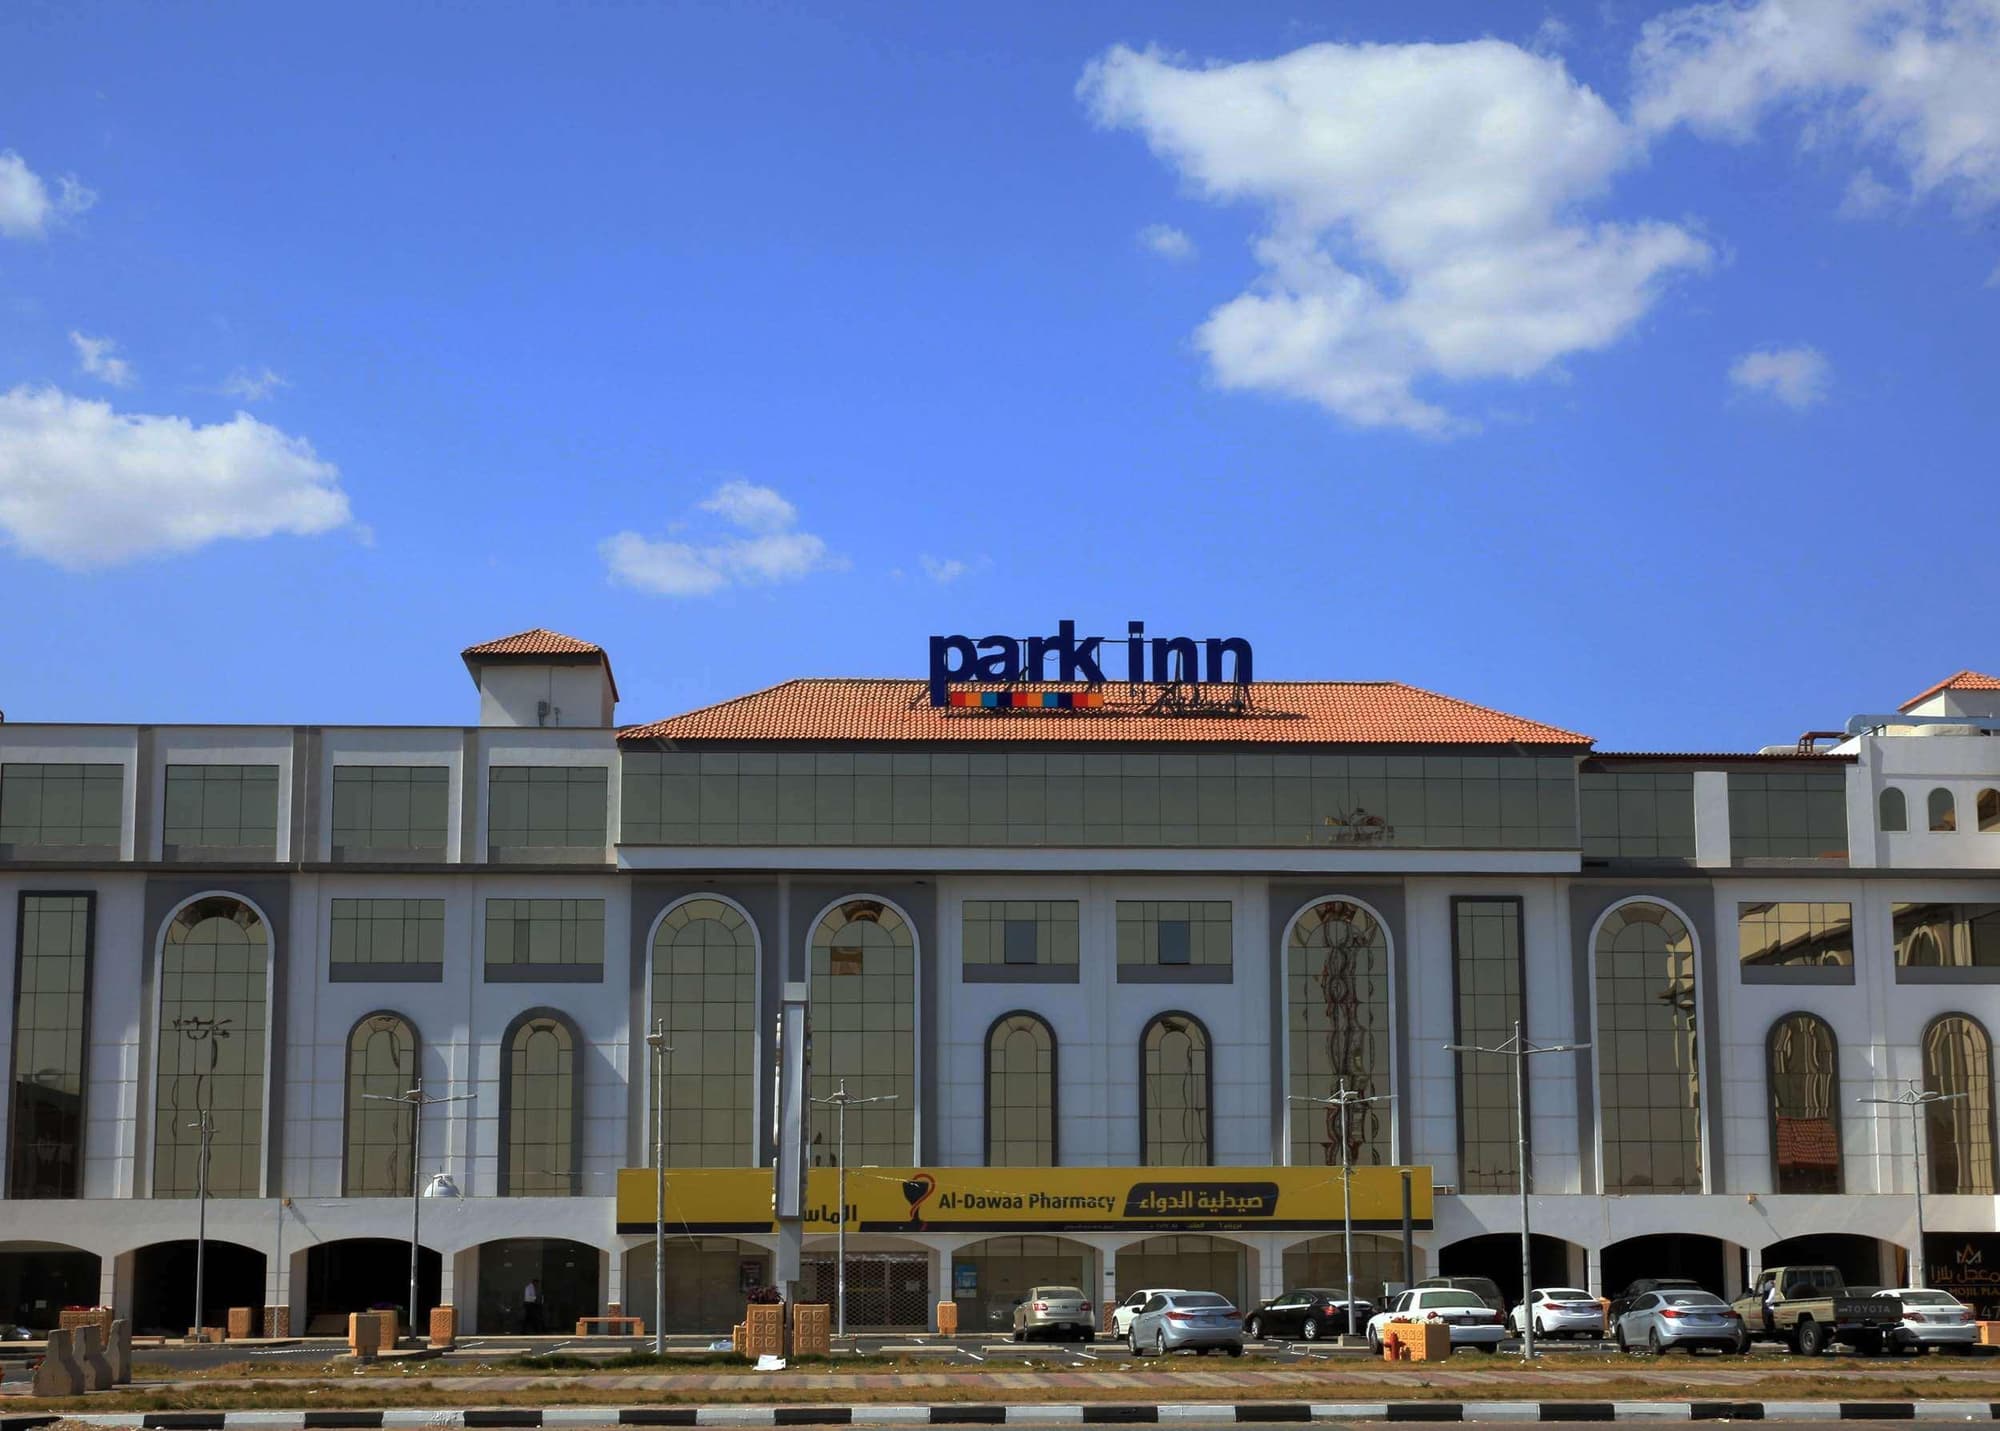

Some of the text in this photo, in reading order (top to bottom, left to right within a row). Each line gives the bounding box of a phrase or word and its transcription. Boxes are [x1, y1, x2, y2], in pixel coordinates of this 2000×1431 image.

[929, 620, 1253, 707] park inn
[939, 1192, 1116, 1213] Al-Dawaa Pharmacy
[1139, 1190, 1263, 1213] صيدلية الدواء
[1847, 1304, 1890, 1313] TOYOTA
